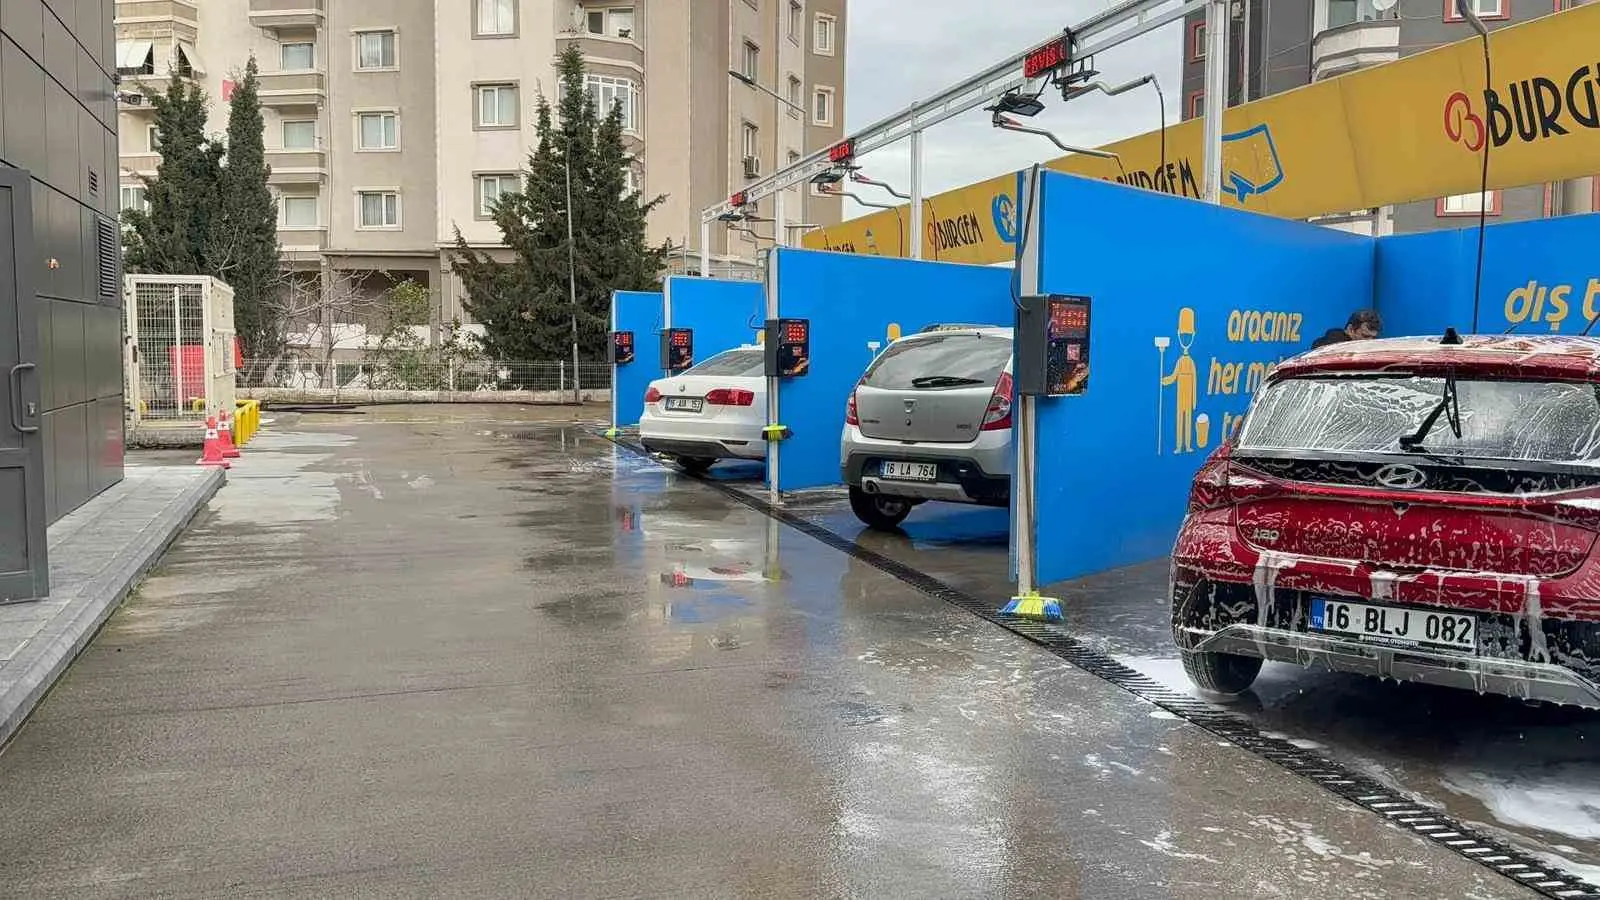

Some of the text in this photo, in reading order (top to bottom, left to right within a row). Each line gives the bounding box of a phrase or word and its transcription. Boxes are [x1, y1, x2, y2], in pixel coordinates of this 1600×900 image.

[1484, 63, 1600, 147] BURG
[936, 211, 984, 250] BURGEM
[1505, 280, 1571, 331] dış
[1227, 309, 1303, 342] aracınız
[1207, 357, 1244, 395] her
[886, 463, 935, 477] 16 LA 764
[1326, 604, 1350, 630] 16
[1364, 608, 1410, 637] BLJ
[1425, 614, 1472, 644] 082
